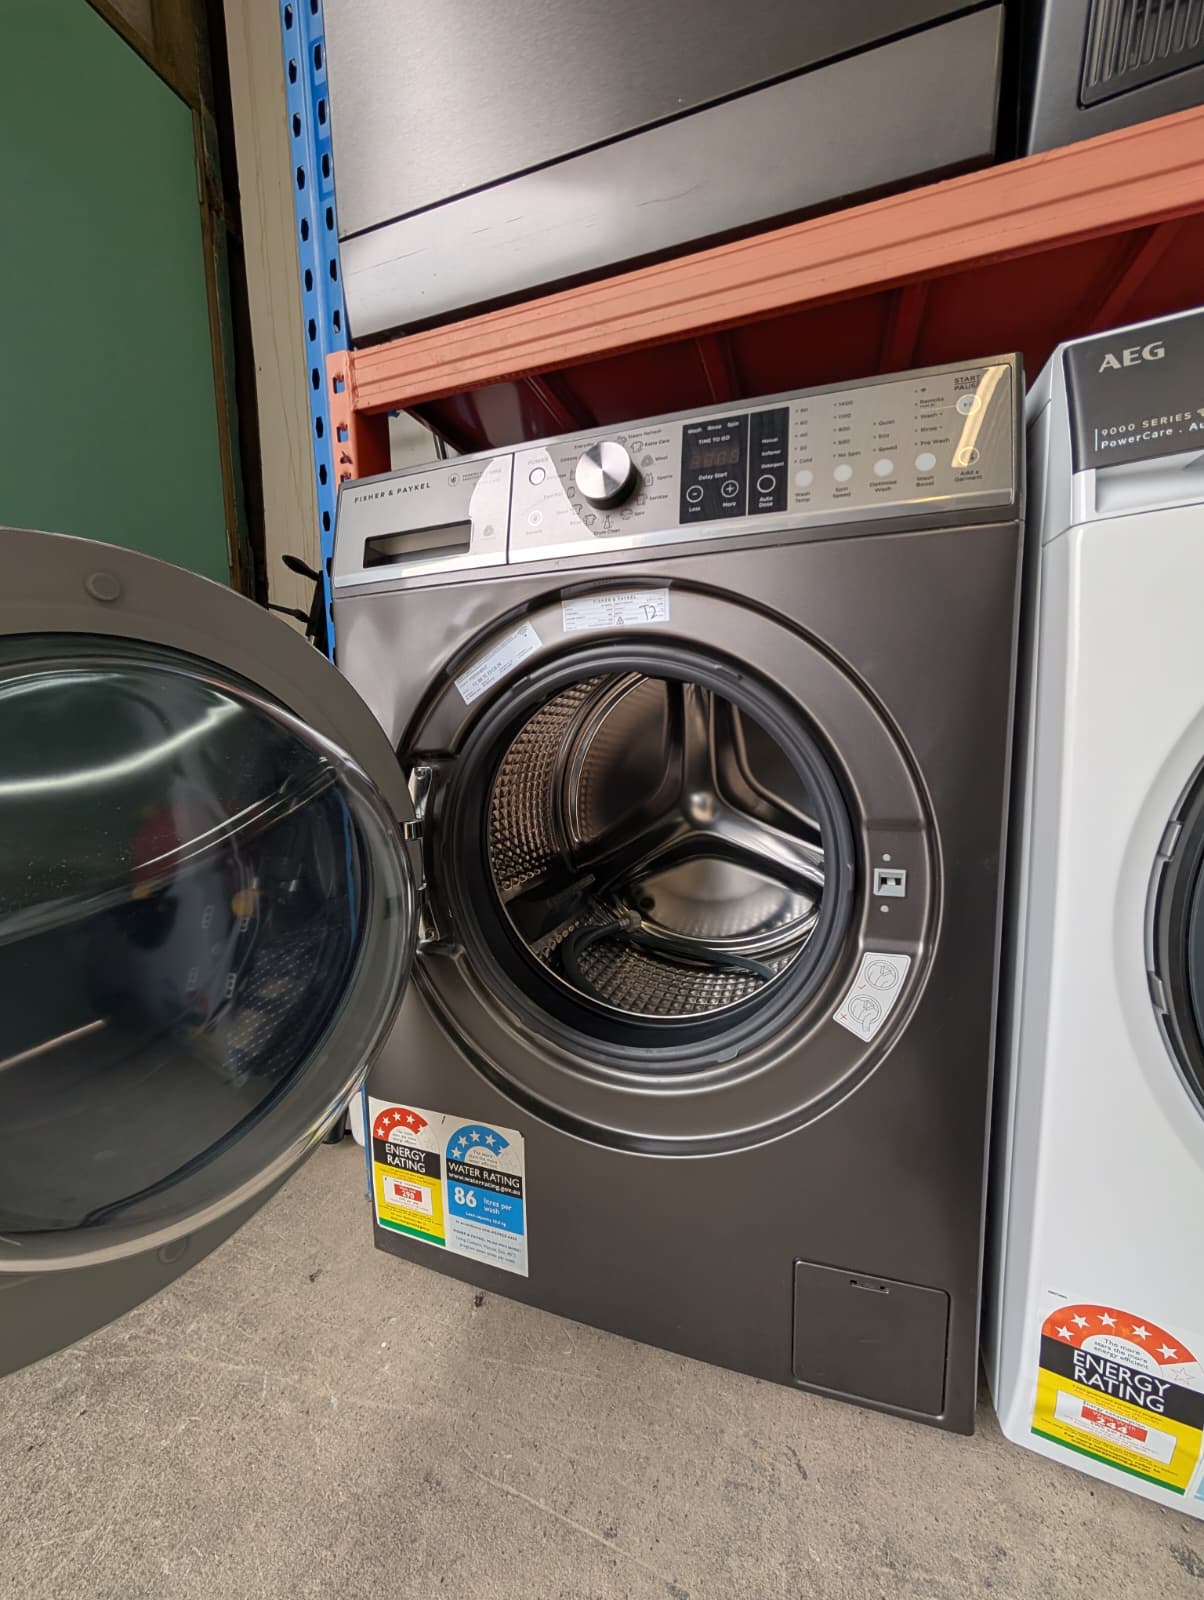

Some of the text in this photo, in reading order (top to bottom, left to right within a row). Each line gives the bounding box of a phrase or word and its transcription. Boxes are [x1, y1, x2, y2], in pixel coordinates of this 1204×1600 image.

[1098, 341, 1165, 372] AEG
[954, 375, 981, 384] START
[1101, 411, 1192, 437] 9000 SERIES
[1101, 428, 1173, 449] PowerCare
[354, 481, 431, 504] FISHER & PAYKEL
[638, 603, 658, 621] T2
[385, 1143, 427, 1163] ENERGY
[387, 1155, 427, 1174] RATING
[448, 1162, 481, 1178] WATER
[483, 1171, 520, 1188] RATING
[454, 1187, 477, 1208] 86
[484, 1206, 500, 1215] wash
[501, 1204, 512, 1212] per
[1104, 1338, 1118, 1347] The
[1073, 1349, 1171, 1397] ENERGY
[1074, 1366, 1166, 1413] RATING
[1096, 1415, 1128, 1434] 244
